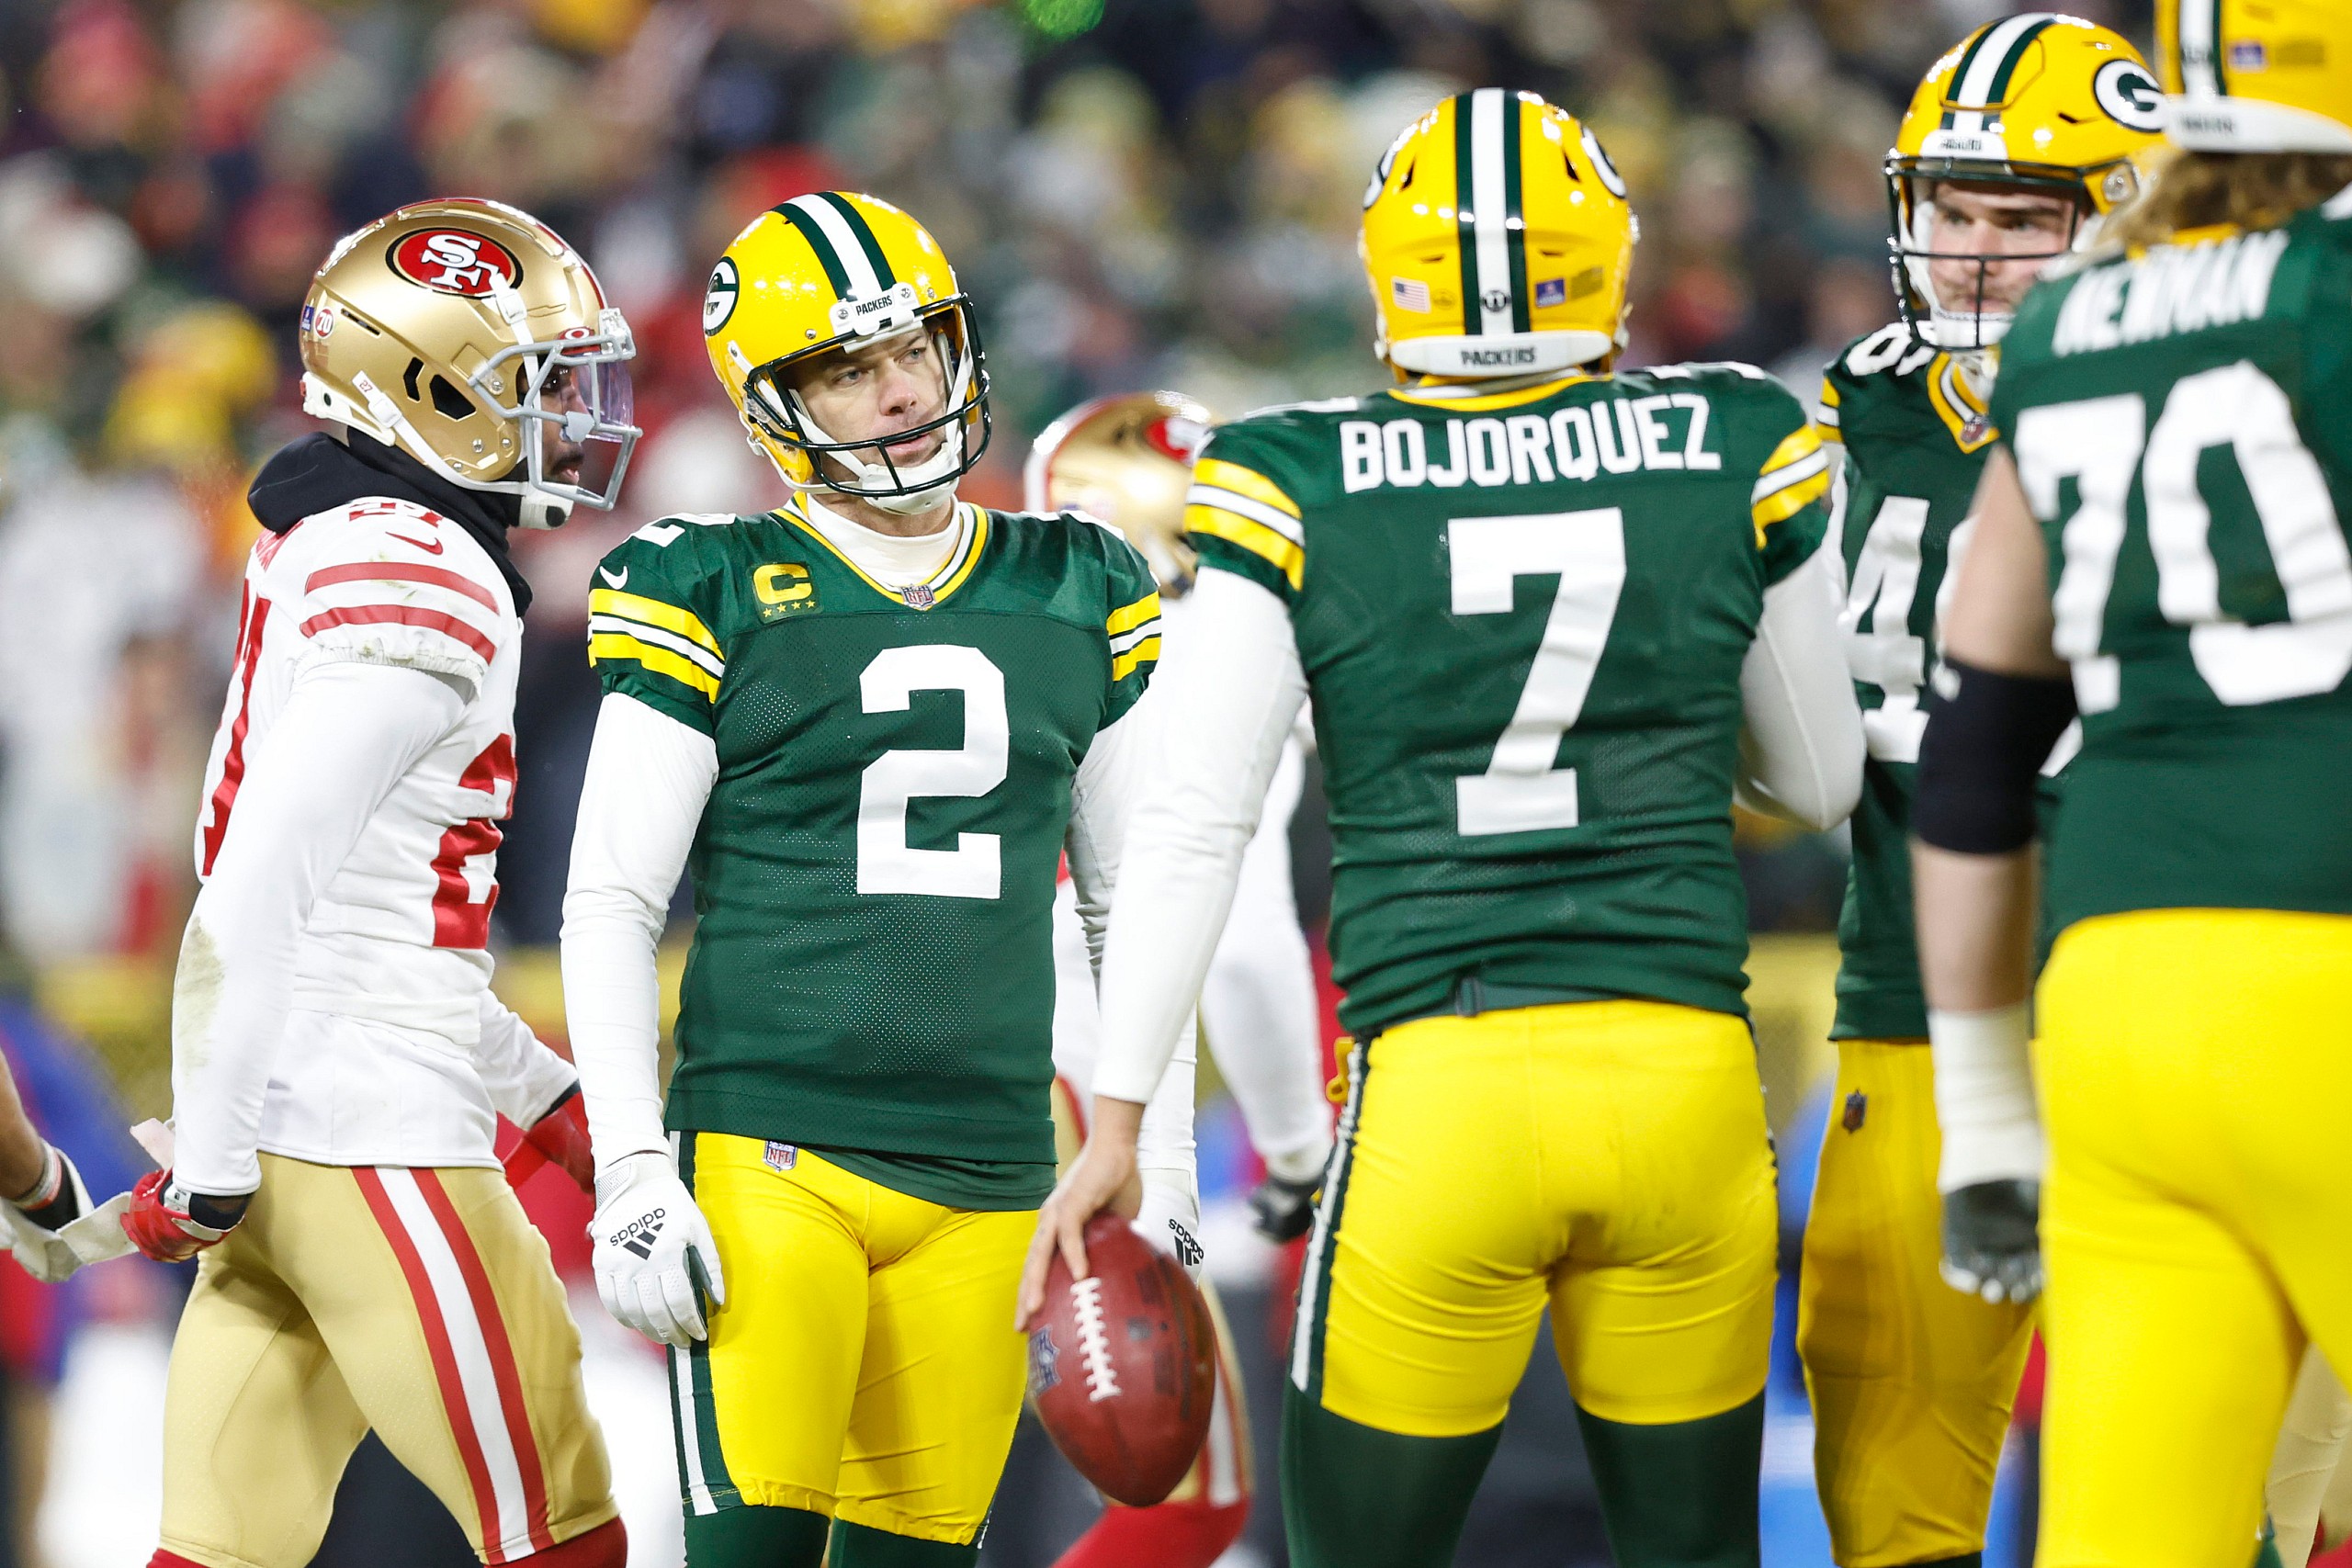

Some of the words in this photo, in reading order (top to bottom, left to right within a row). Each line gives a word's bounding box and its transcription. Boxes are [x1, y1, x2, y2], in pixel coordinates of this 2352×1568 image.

[316, 313, 334, 333] 70
[855, 295, 893, 316] PACKERS
[1339, 392, 1722, 494] BOJORQUEZ
[2014, 357, 2352, 716] 70
[753, 563, 812, 605] C
[906, 592, 932, 604] NFL
[1447, 505, 1627, 837] 7
[855, 643, 1010, 900] 2
[768, 1150, 792, 1165] NFL
[609, 1207, 666, 1247] adidas
[1168, 1218, 1204, 1260] adidas
